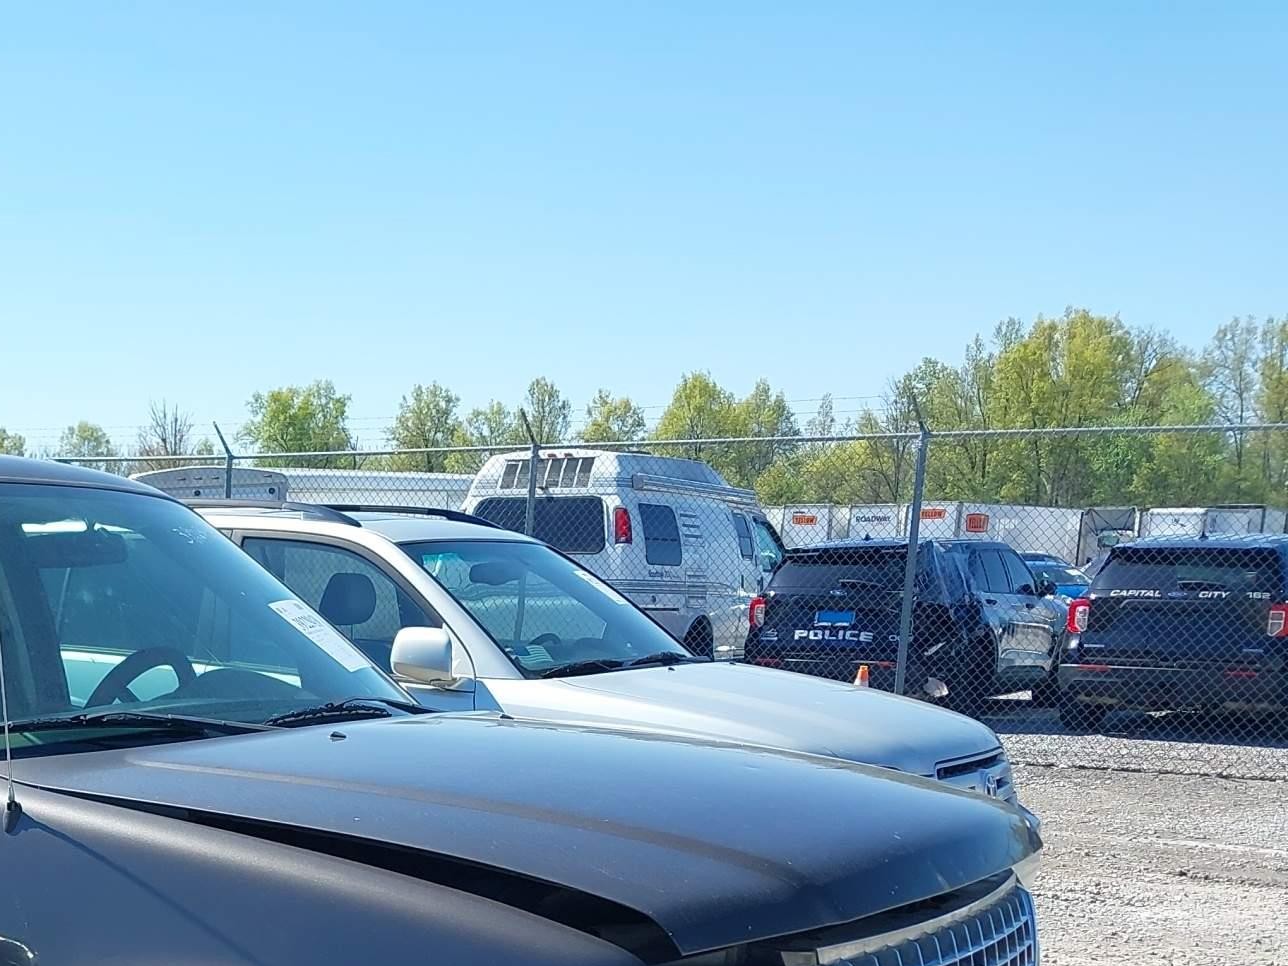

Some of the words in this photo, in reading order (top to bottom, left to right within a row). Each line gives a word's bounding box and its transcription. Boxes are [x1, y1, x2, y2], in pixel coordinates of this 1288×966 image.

[855, 515, 891, 523] ROADWAY
[1110, 589, 1162, 598] CAPITAL
[1198, 591, 1231, 599] CITY
[794, 629, 873, 642] POLICE
